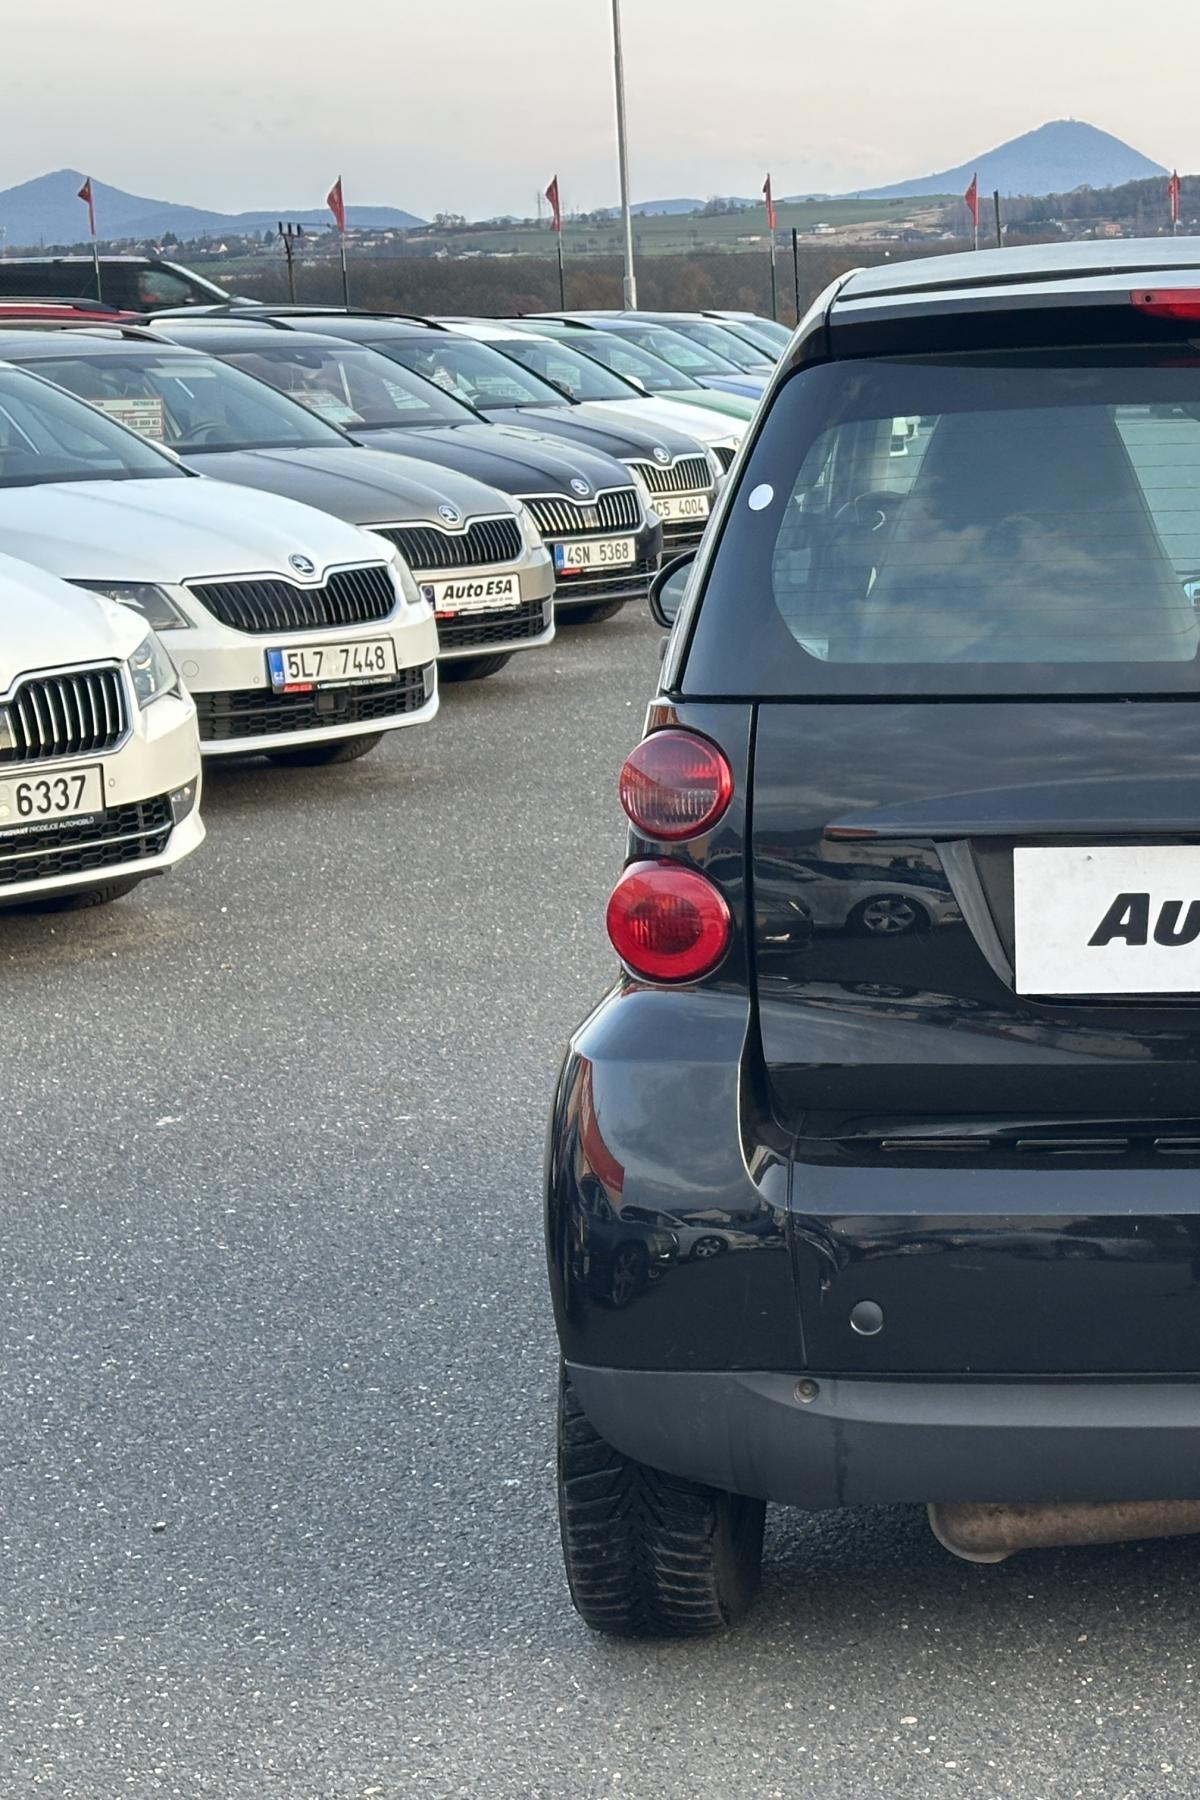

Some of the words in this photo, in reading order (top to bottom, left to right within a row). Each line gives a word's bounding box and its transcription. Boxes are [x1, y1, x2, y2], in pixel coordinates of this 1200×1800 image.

[679, 499, 704, 515] 4004
[567, 546, 591, 564] 4SN
[600, 542, 629, 561] 5368
[443, 583, 483, 600] Auto
[485, 579, 512, 596] ESA
[287, 650, 323, 679] 5L7
[339, 645, 385, 674] 7448
[16, 774, 86, 817] 6337
